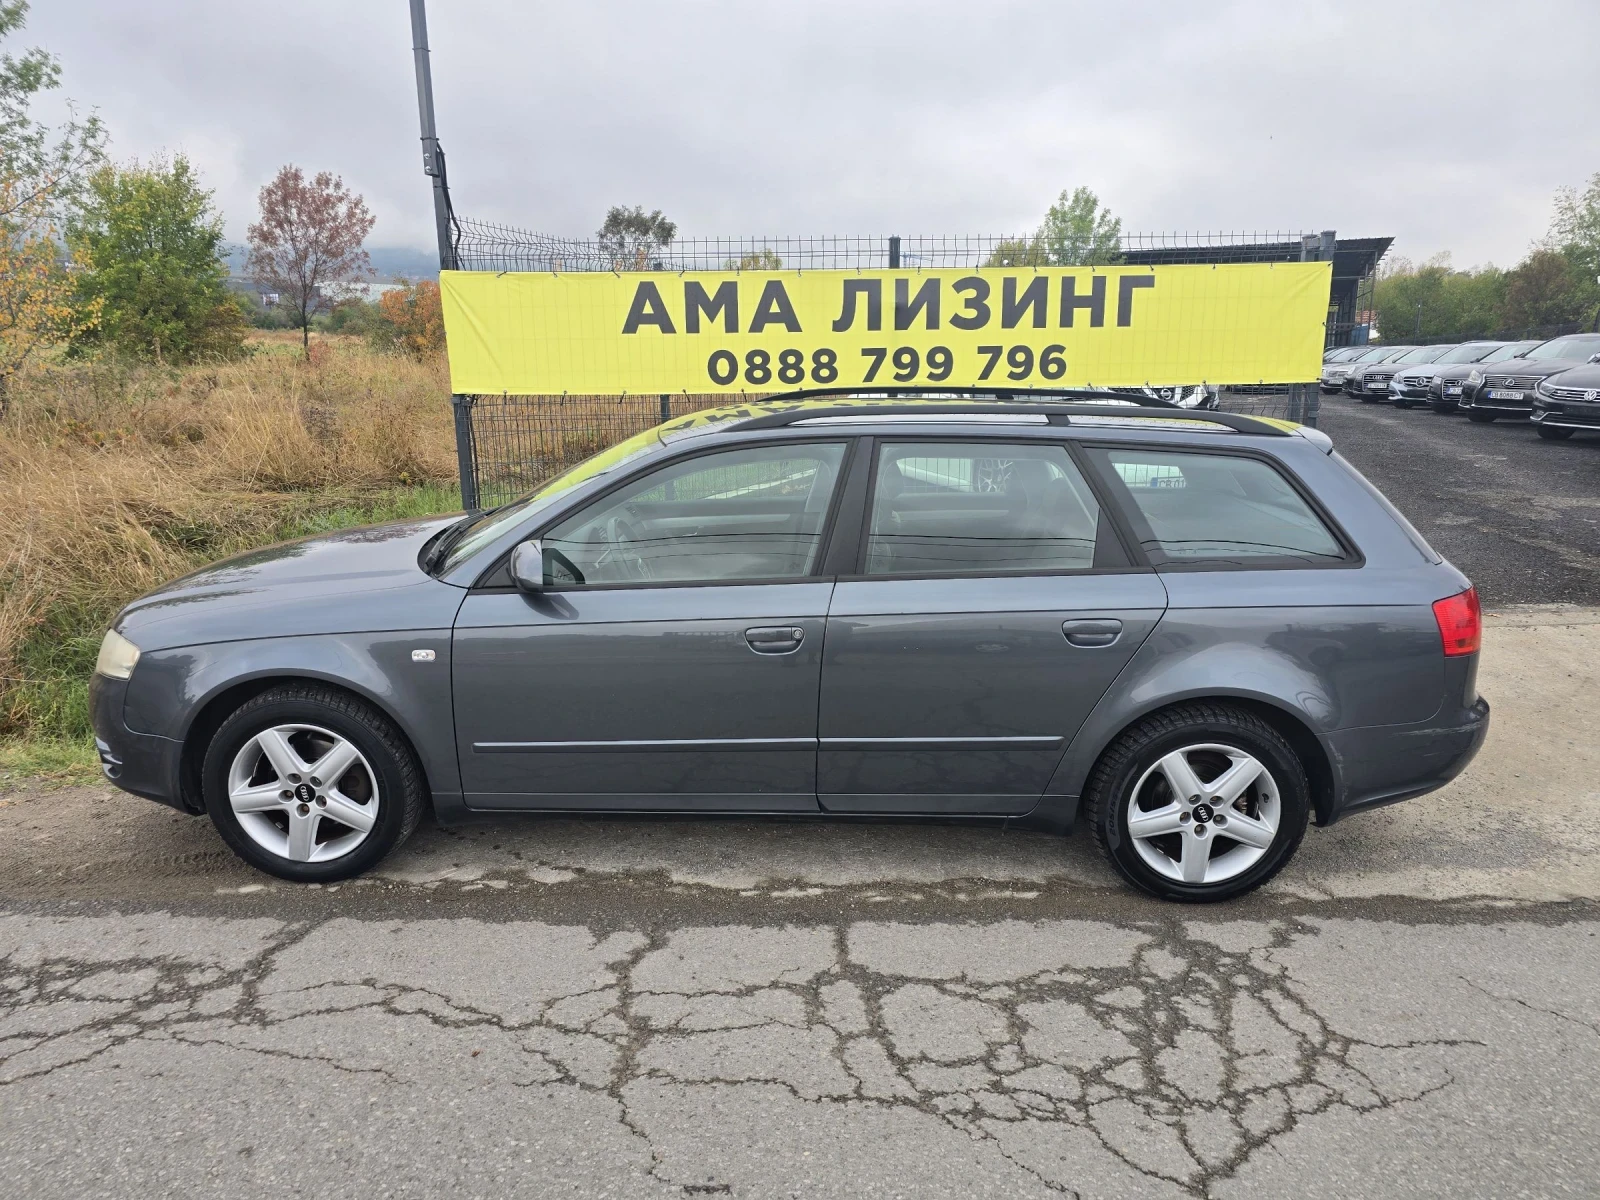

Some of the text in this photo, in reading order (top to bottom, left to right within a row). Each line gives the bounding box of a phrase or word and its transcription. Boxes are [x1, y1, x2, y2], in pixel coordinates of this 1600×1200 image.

[622, 275, 1155, 335] АМА ЛИЗИНГ
[707, 344, 1067, 386] 0888 799 796
